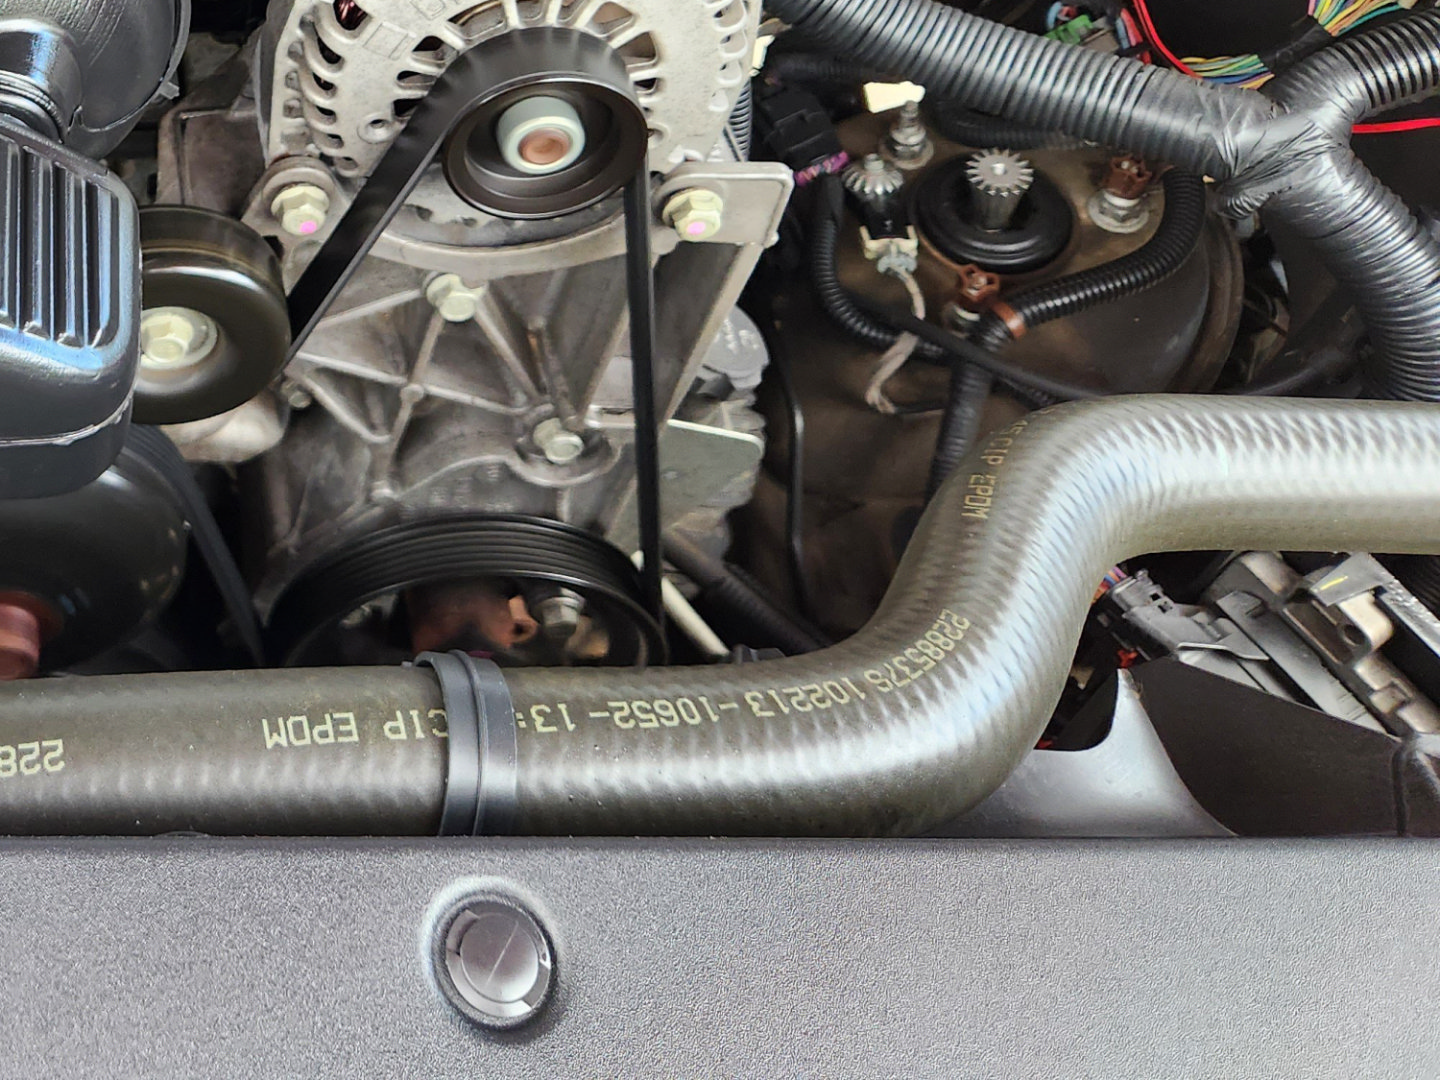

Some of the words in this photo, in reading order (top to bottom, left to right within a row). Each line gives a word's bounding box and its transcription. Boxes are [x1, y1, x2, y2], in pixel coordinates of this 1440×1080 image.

[961, 474, 997, 520] EPDM
[863, 608, 971, 694] 22885376
[744, 676, 866, 718] 102213
[261, 711, 359, 750] EPDM
[382, 708, 449, 740] CIP
